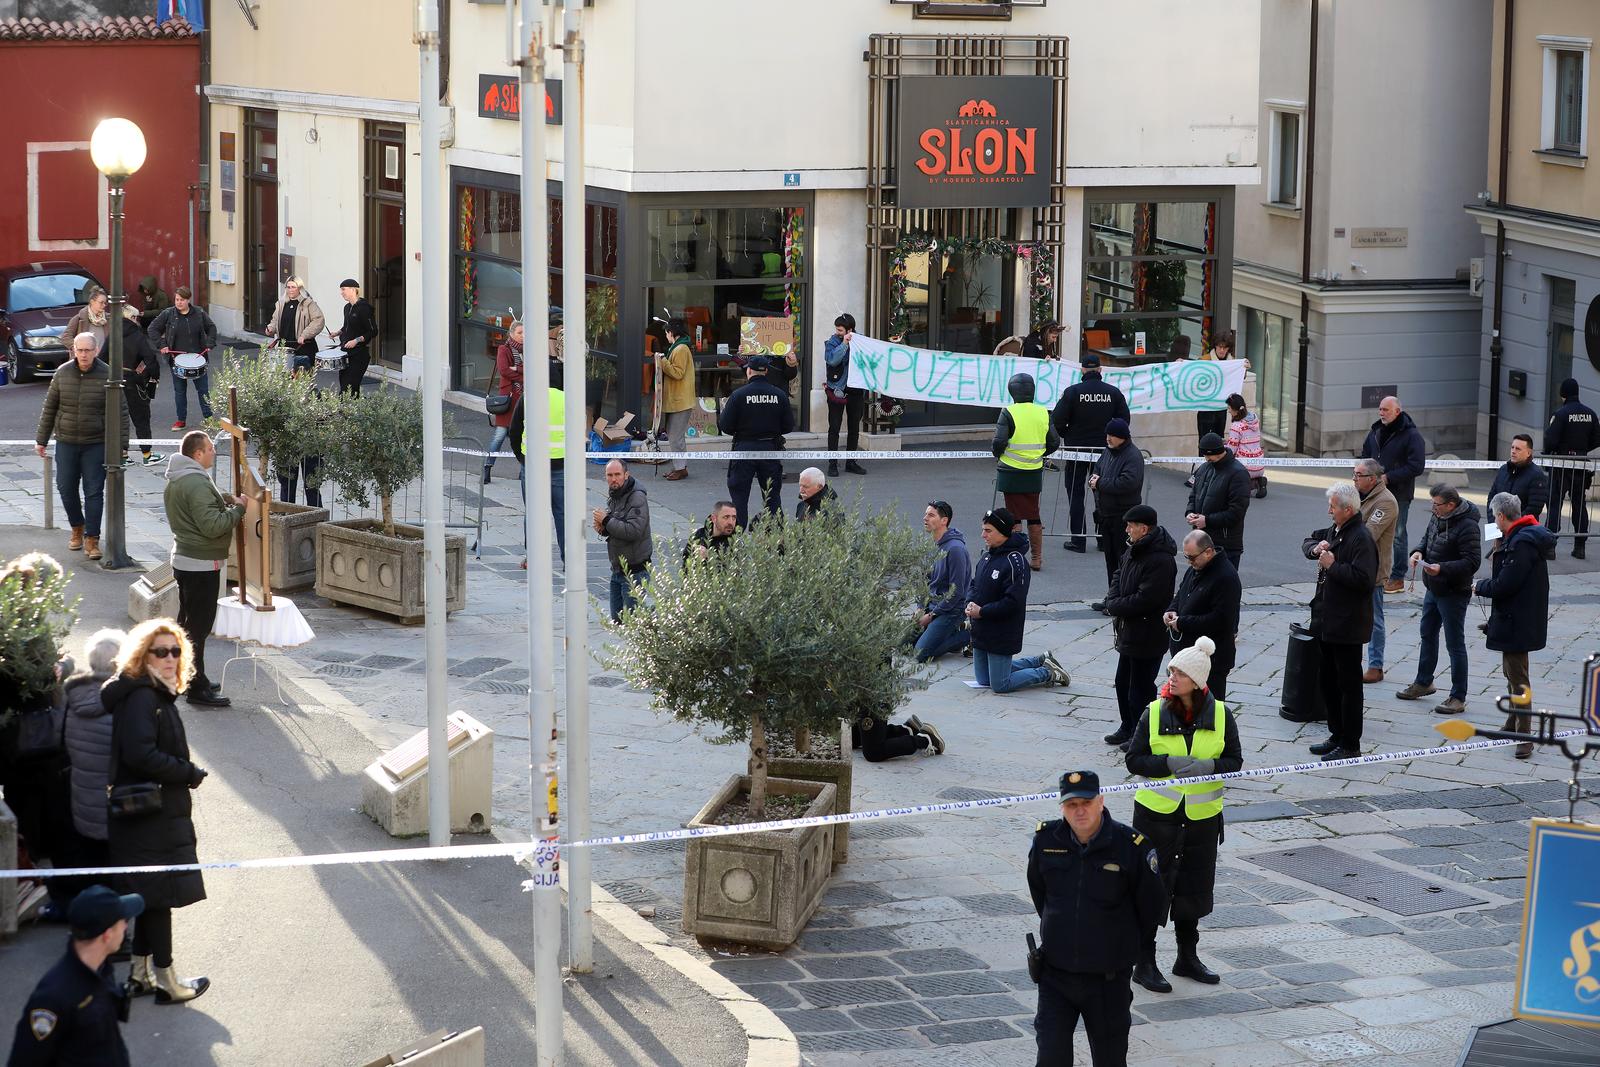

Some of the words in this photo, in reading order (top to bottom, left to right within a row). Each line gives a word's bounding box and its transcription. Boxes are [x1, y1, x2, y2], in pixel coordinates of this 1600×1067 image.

[914, 127, 1038, 176] SLON
[789, 173, 795, 183] 4
[979, 176, 1024, 184] DEBARTOLI
[756, 321, 791, 331] SNAILED
[762, 334, 772, 342] IT
[884, 347, 1016, 403] PUŽEVNI
[746, 394, 779, 404] POLICIJA
[1079, 393, 1112, 403] POLICIJA
[1568, 413, 1592, 423] POLICIJA
